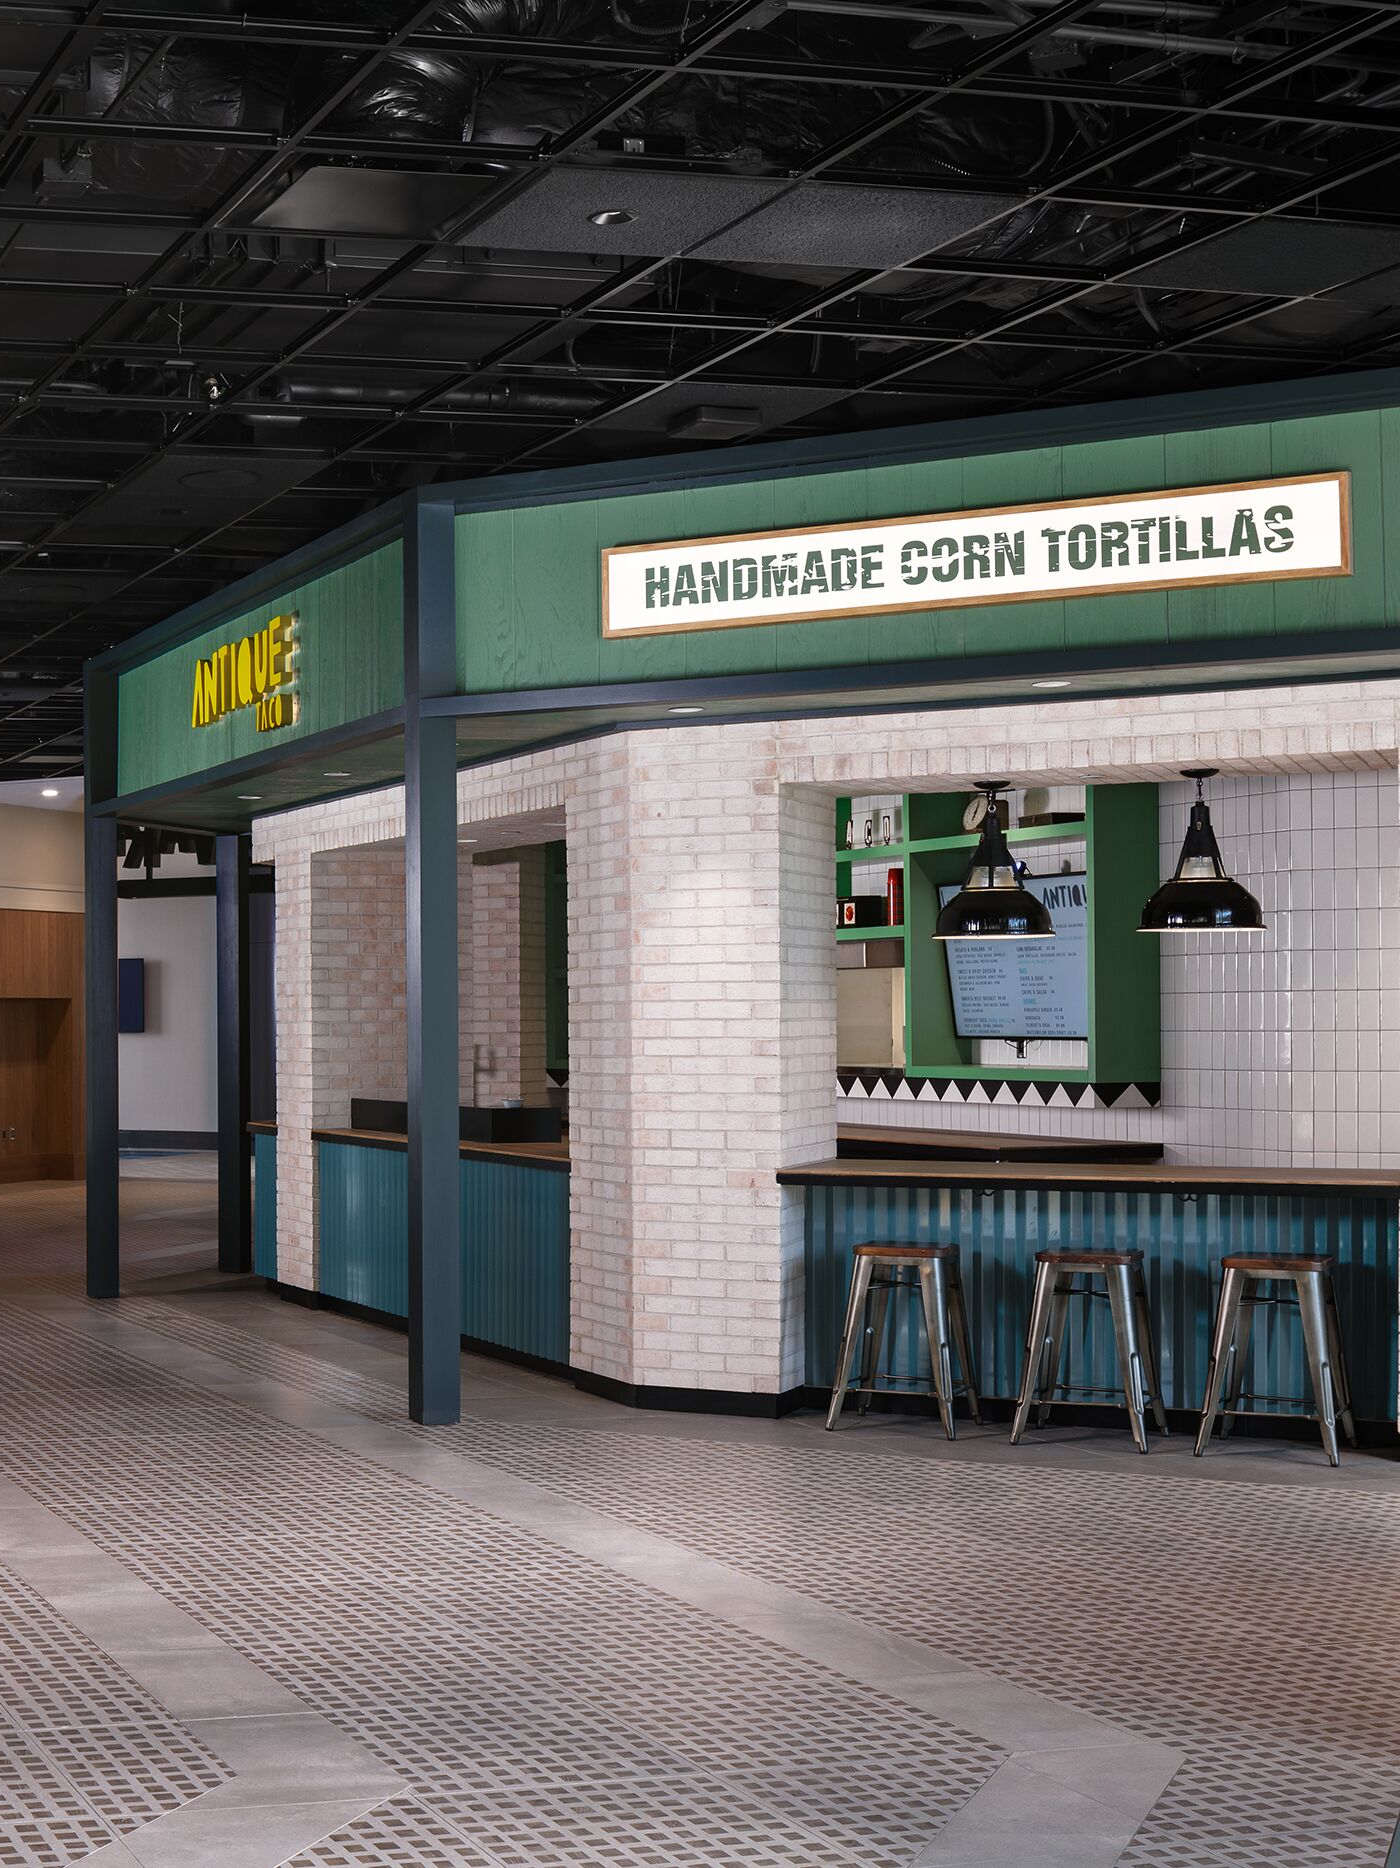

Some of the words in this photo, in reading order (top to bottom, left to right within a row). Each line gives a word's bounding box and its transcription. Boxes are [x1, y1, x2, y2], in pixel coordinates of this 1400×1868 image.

[645, 543, 885, 609] HANDMADE
[899, 530, 1026, 585] CORN
[1041, 504, 1295, 575] TORTILLAS
[192, 615, 287, 729] ANTIQUE
[256, 694, 287, 732] TACO
